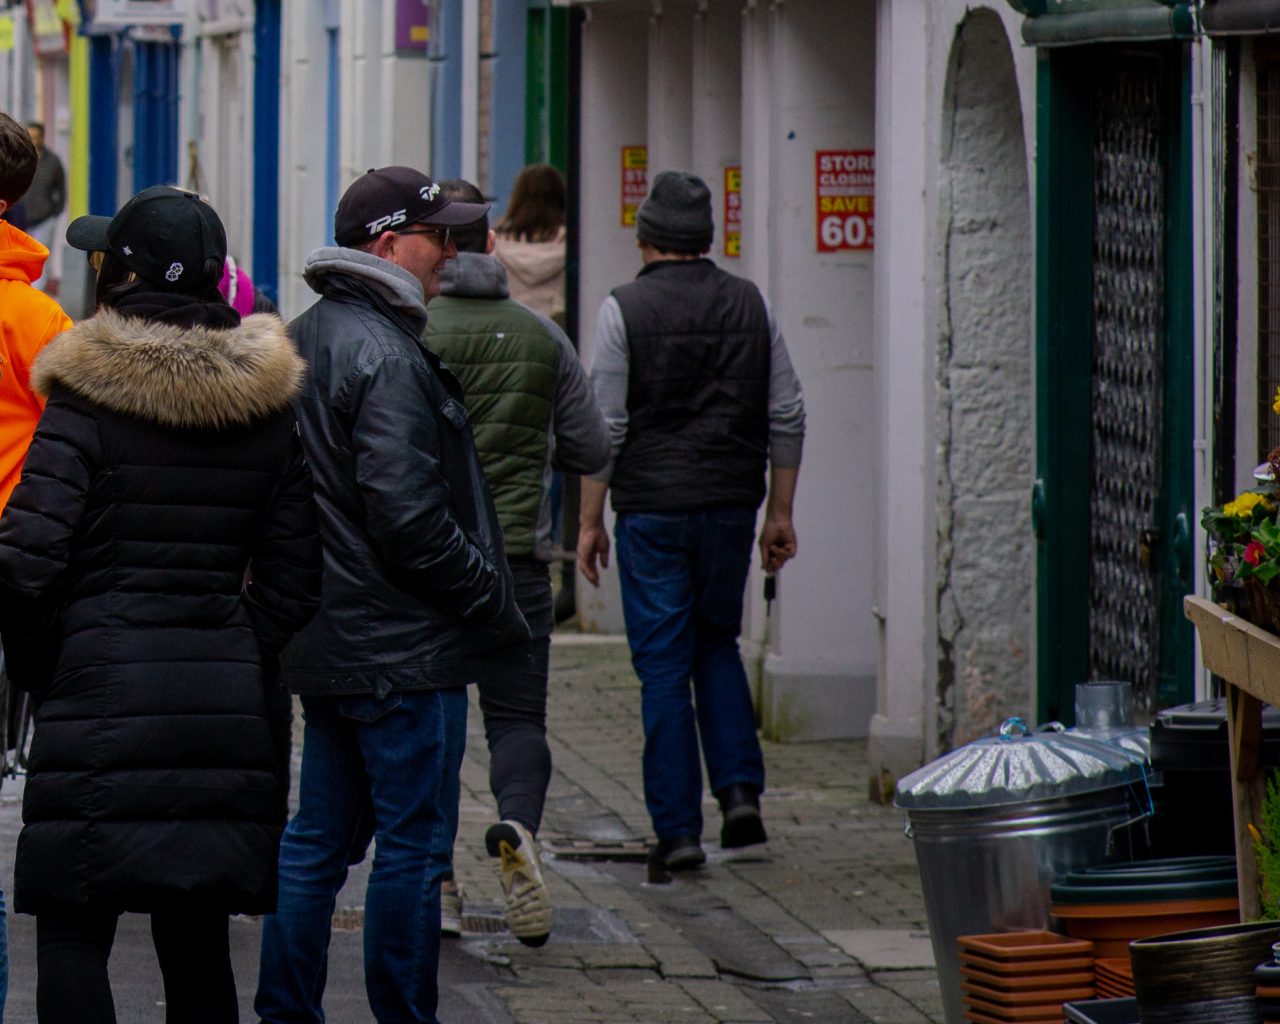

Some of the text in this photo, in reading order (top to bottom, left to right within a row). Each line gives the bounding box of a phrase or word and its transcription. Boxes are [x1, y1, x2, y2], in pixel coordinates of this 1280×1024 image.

[821, 156, 874, 172] STOR
[821, 173, 873, 186] CLOSIN
[821, 197, 869, 213] SAVE
